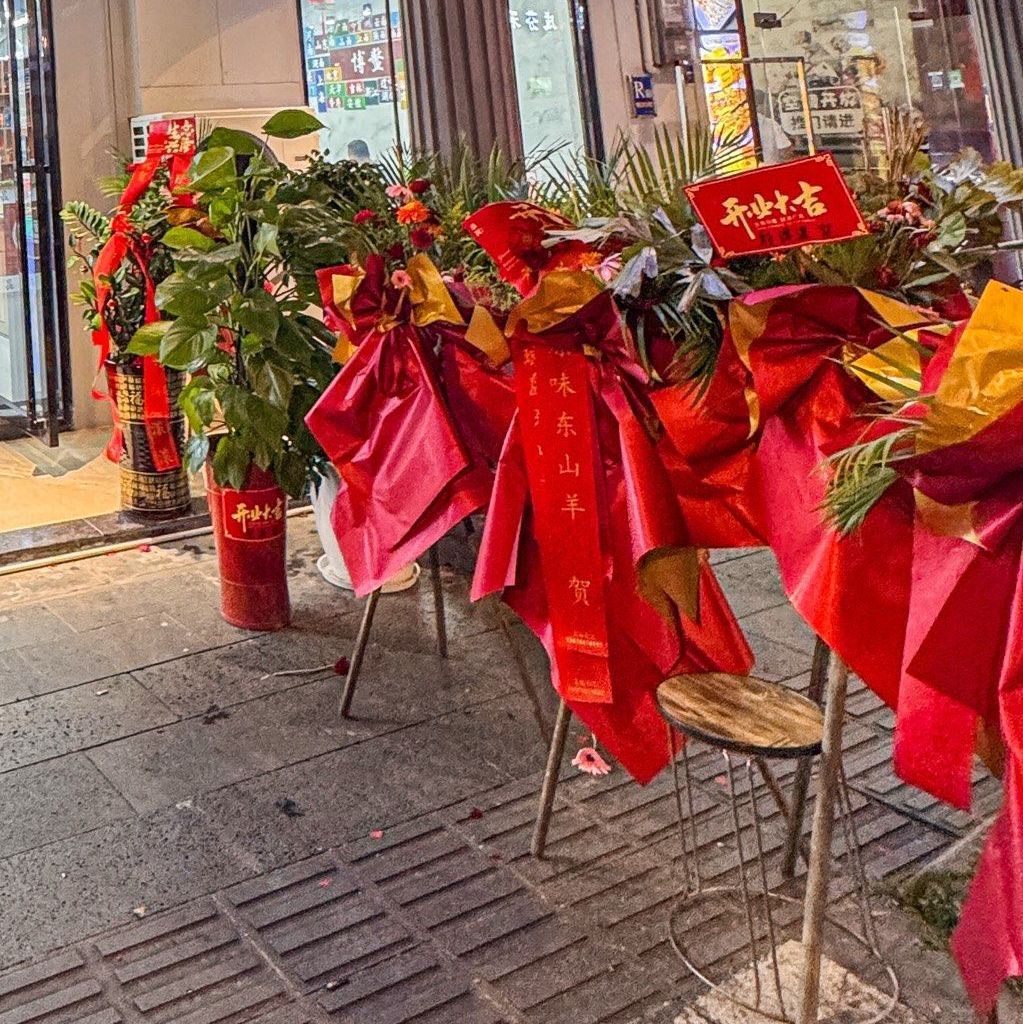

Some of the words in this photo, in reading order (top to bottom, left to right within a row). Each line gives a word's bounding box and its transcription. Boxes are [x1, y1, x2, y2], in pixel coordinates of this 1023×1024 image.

[720, 181, 828, 240] 开业大吉
[549, 348, 586, 521] 味东山羊
[568, 576, 590, 607] 贺
[231, 498, 283, 533] 开业大吉
